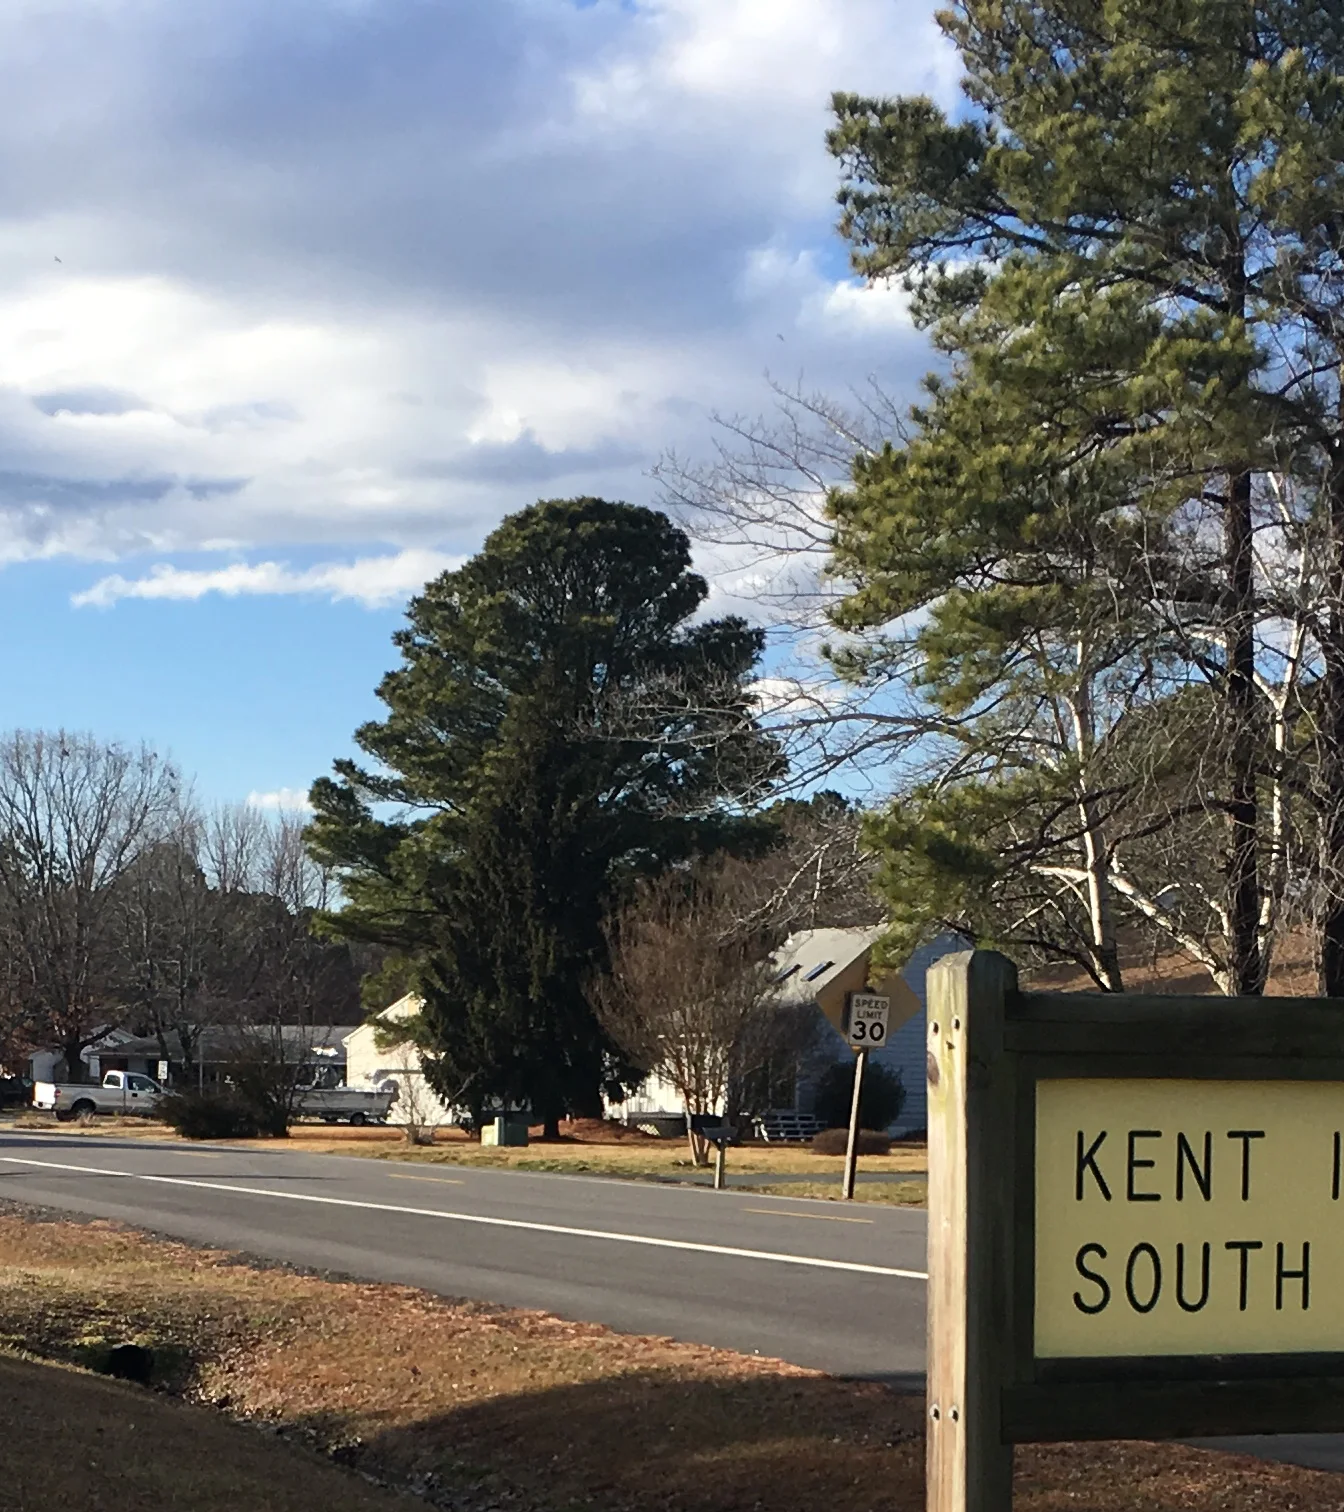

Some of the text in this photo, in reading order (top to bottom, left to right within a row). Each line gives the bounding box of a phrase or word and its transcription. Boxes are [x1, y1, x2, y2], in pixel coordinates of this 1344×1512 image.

[855, 998, 888, 1009] SPEED
[857, 1010, 882, 1019] LIMIT
[852, 1020, 884, 1041] 30
[1075, 1130, 1265, 1202] KENT
[1072, 1240, 1311, 1315] SOUTH
